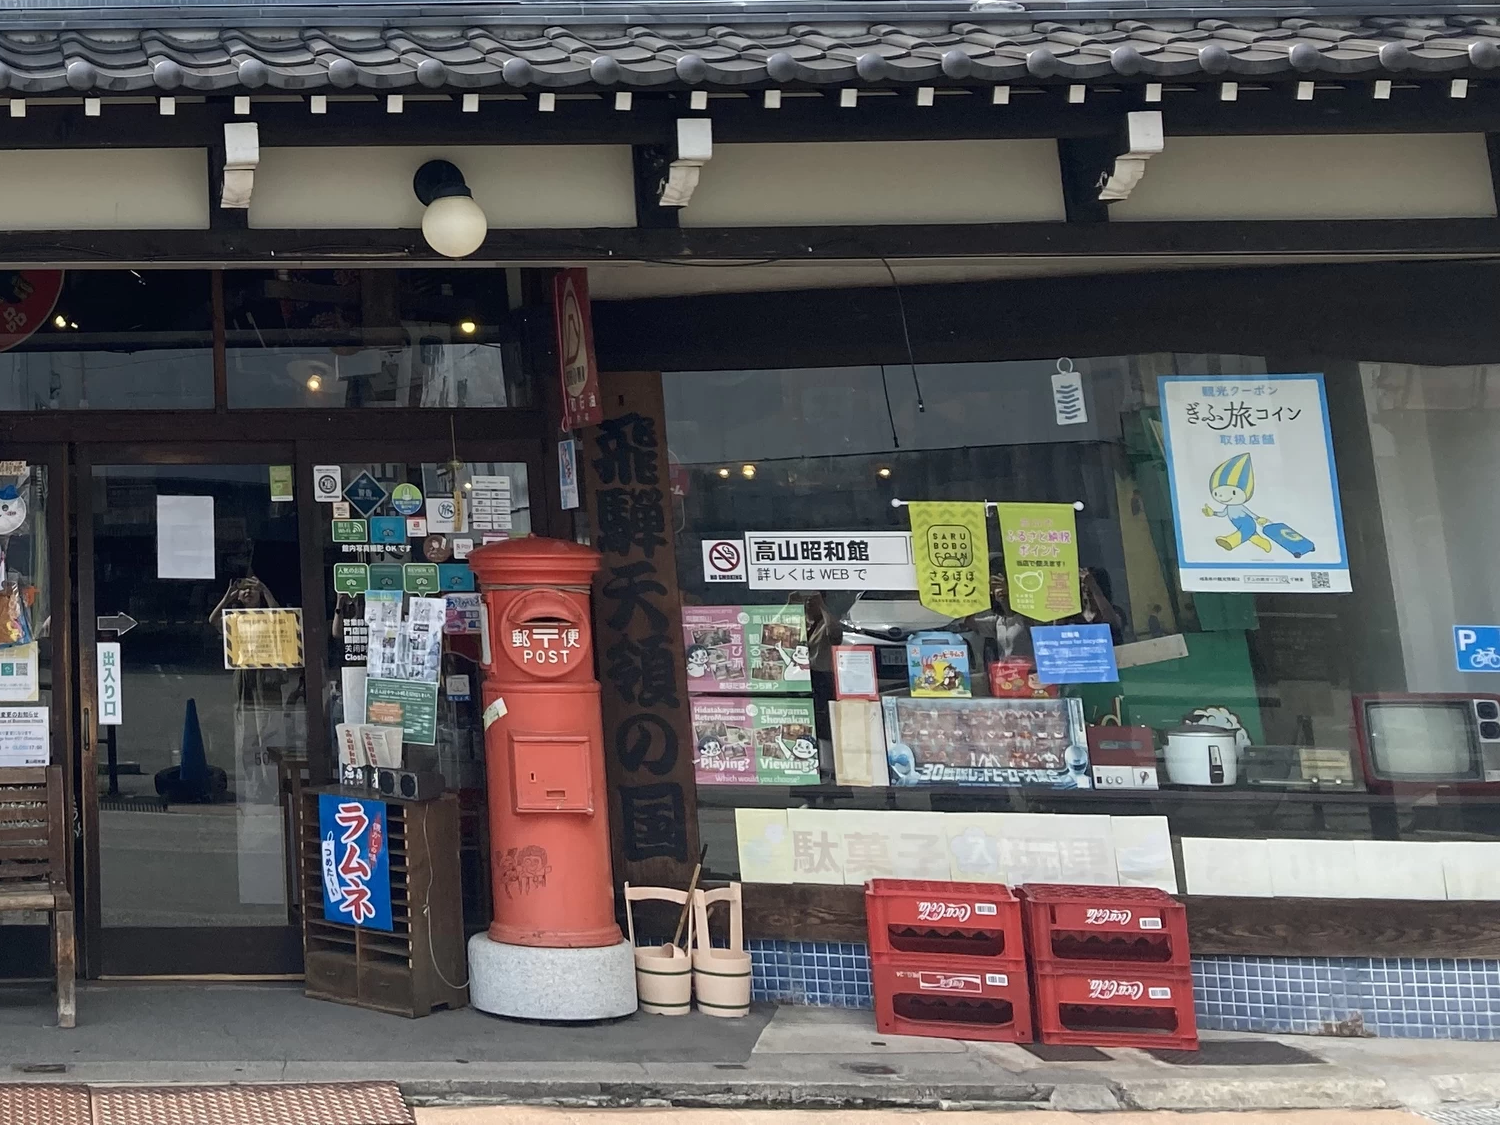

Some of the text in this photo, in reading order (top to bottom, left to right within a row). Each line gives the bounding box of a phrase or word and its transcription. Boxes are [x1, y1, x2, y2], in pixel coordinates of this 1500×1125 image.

[1202, 384, 1278, 397] 観光クーポン
[1185, 401, 1302, 430] ぎふ旅コイン
[1220, 434, 1275, 445] 取扱店舗
[932, 532, 966, 541] SARU
[1006, 530, 1071, 543] ふるさと納税
[399, 545, 412, 553] です
[754, 539, 869, 563] 高山昭和館
[933, 542, 968, 550] BOBO
[1019, 545, 1061, 557] ポイント
[757, 567, 867, 581] 詳しくは WEB で
[928, 570, 975, 582] さるぼぼ
[931, 583, 976, 597] コイン
[1458, 631, 1477, 651] P
[524, 650, 570, 664] POST
[102, 651, 116, 717] 出入り口
[760, 706, 808, 716] Takayama
[761, 716, 810, 724] Showakan
[701, 758, 750, 772] Playing?
[760, 758, 815, 772] Viewing?
[715, 775, 736, 783] Which
[738, 775, 758, 783] would
[760, 776, 773, 784] you
[335, 802, 376, 924] ラムネ
